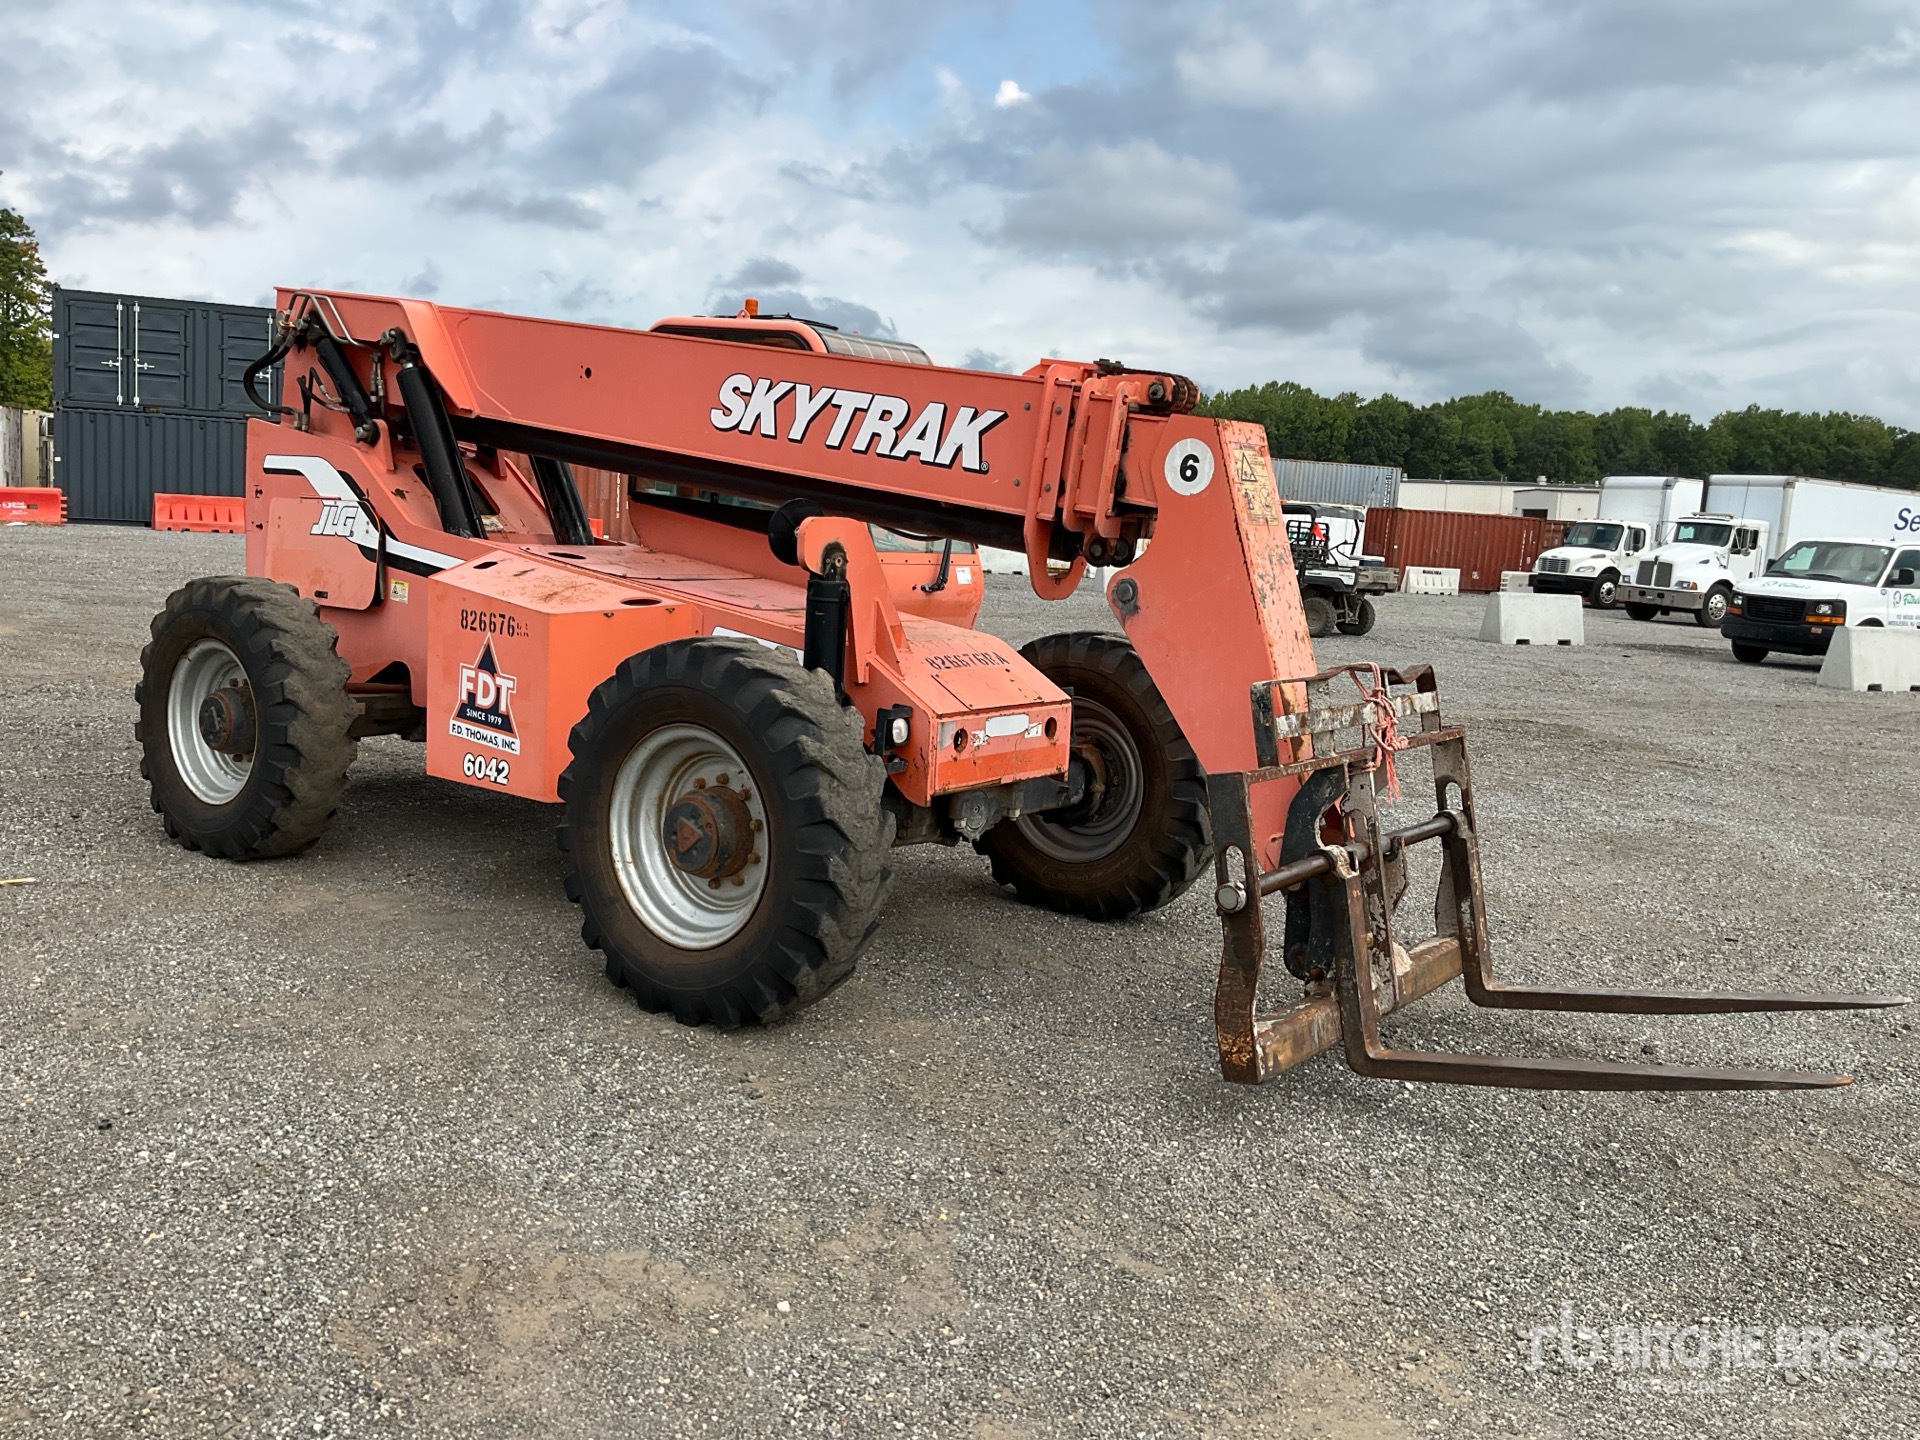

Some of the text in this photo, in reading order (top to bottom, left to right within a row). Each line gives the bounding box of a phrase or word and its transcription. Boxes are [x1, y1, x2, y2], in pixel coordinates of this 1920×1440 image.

[709, 373, 1008, 472] SKYTRAK
[1180, 453, 1200, 482] 6
[309, 504, 359, 537] JLG
[460, 667, 514, 712] FDT
[466, 708, 502, 725] SINCE 1979
[451, 723, 517, 752] F.D. THOMAS, INC.
[463, 752, 510, 785] 6042
